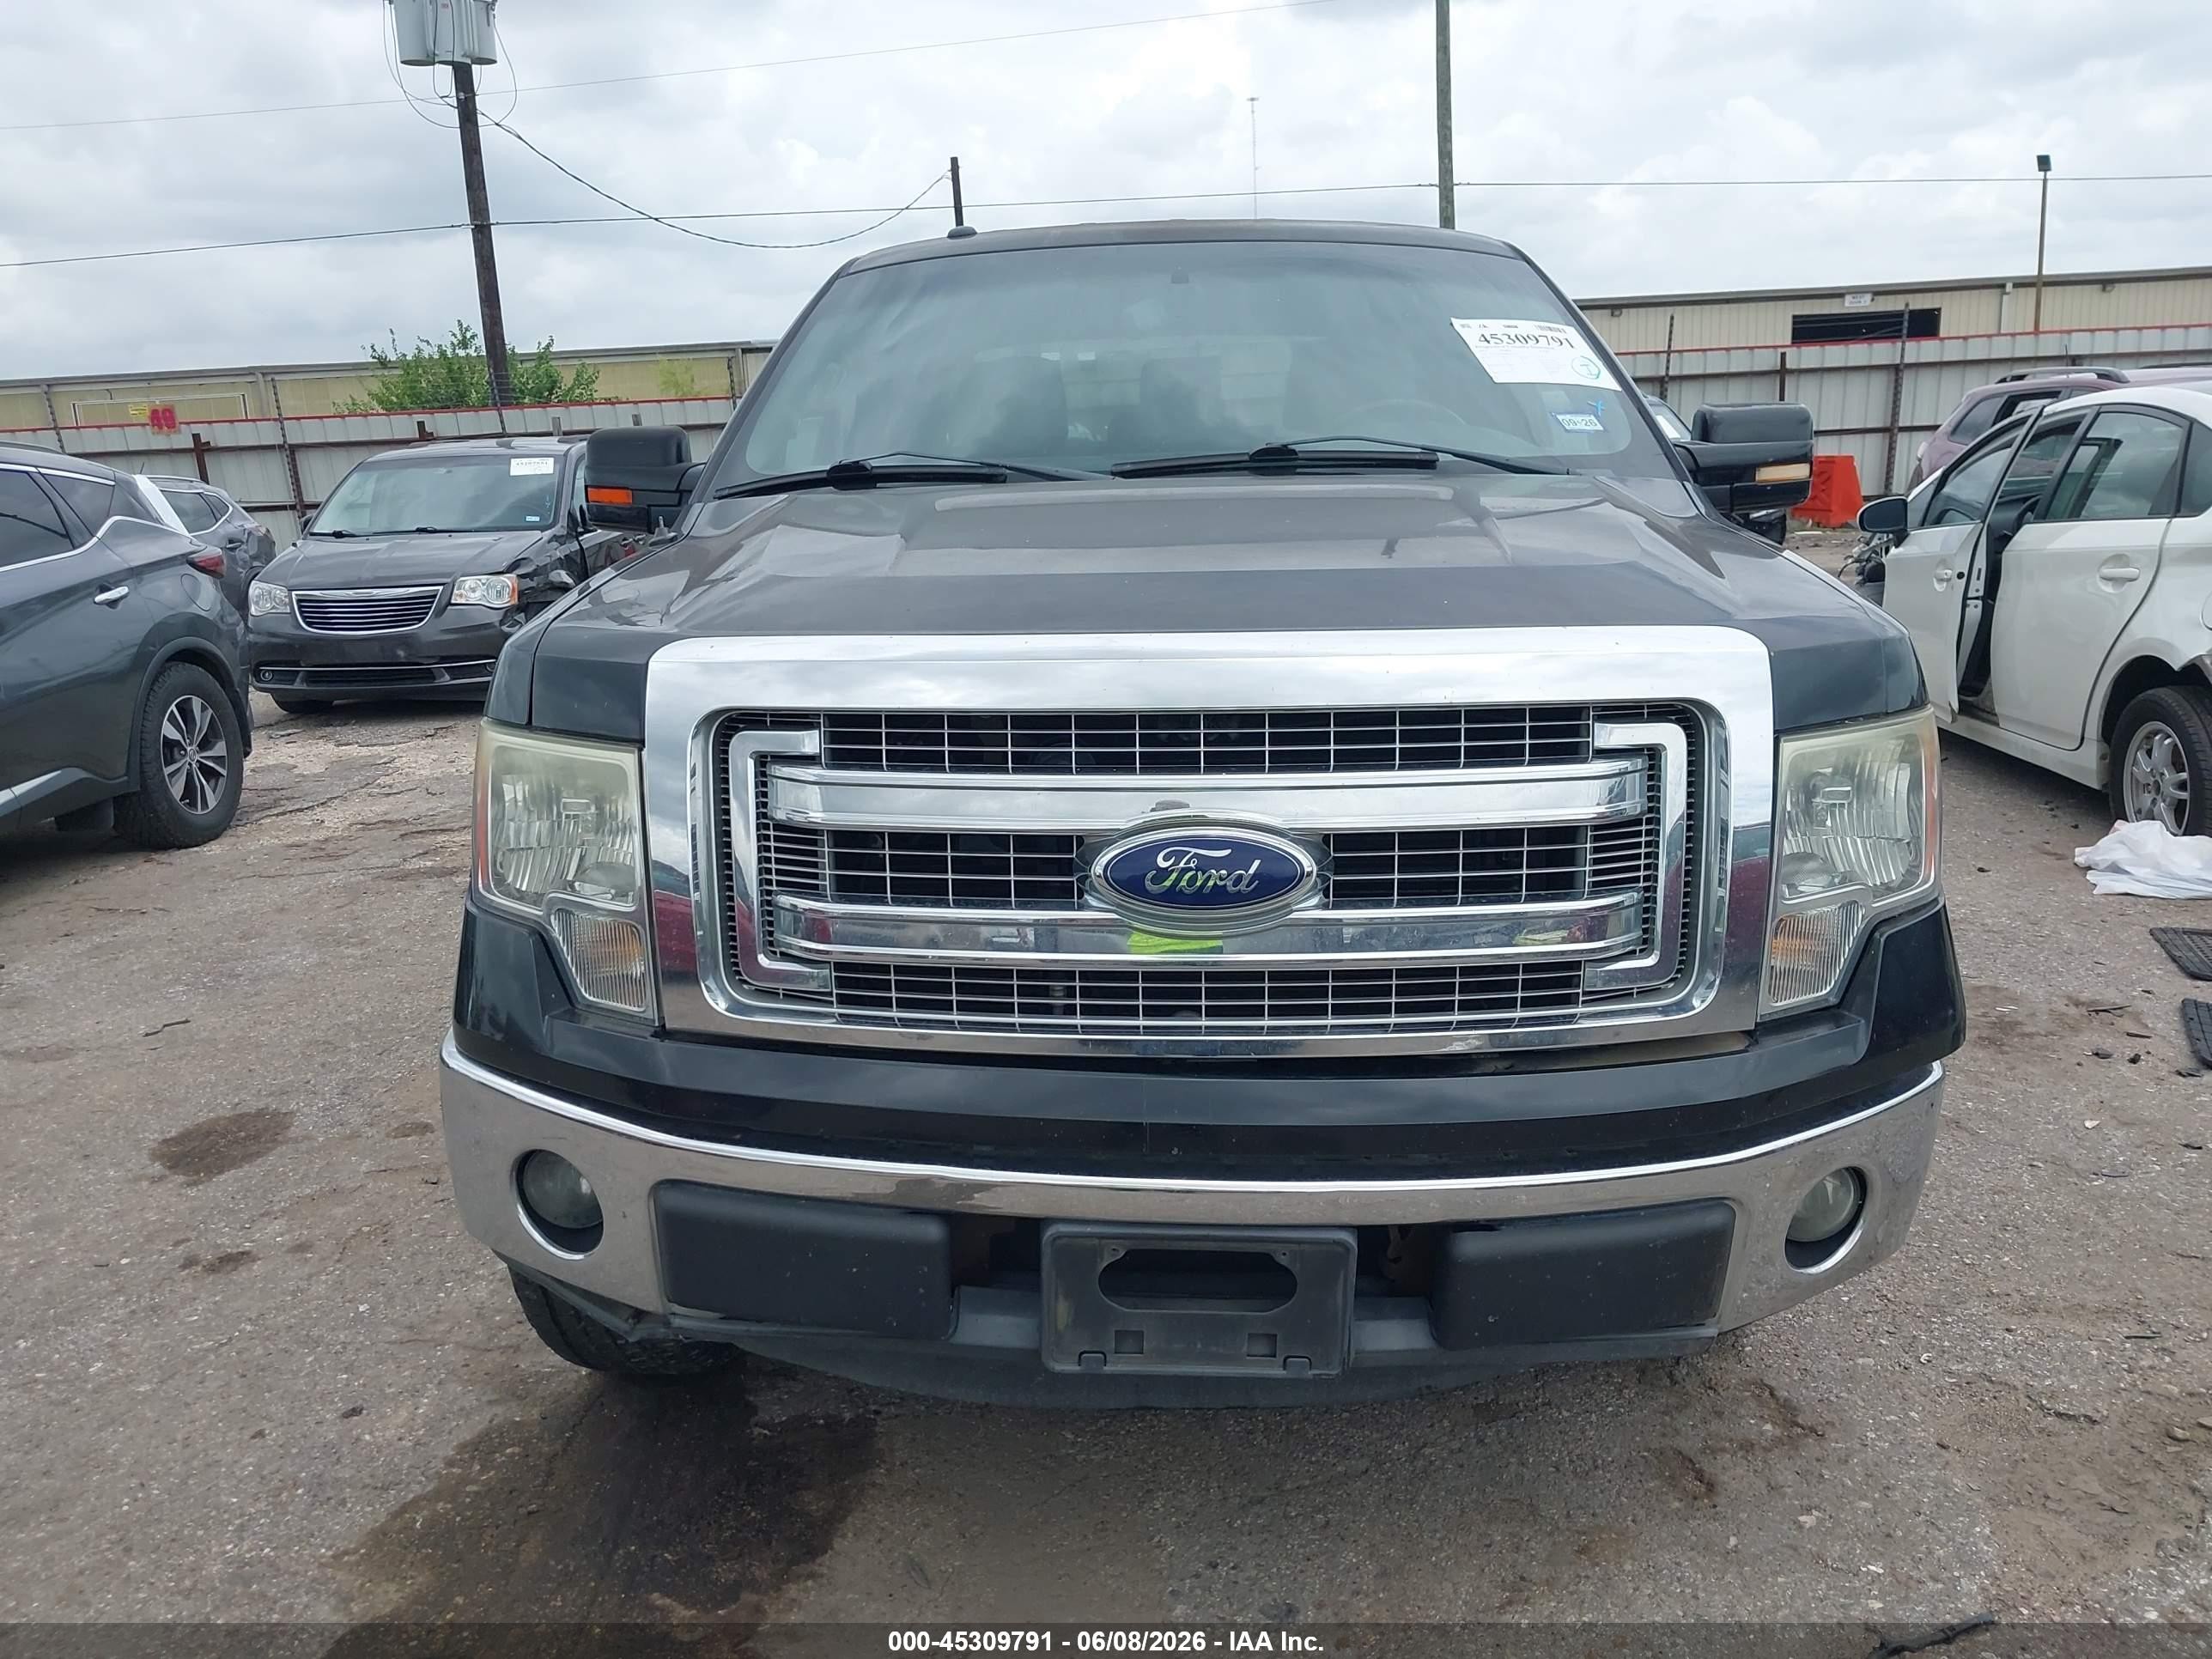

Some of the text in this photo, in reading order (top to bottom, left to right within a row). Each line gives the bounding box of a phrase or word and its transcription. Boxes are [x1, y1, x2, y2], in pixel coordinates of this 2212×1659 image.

[1478, 333, 1574, 349] 45309791
[1581, 418, 1598, 427] 26
[1145, 846, 1262, 895] Ford
